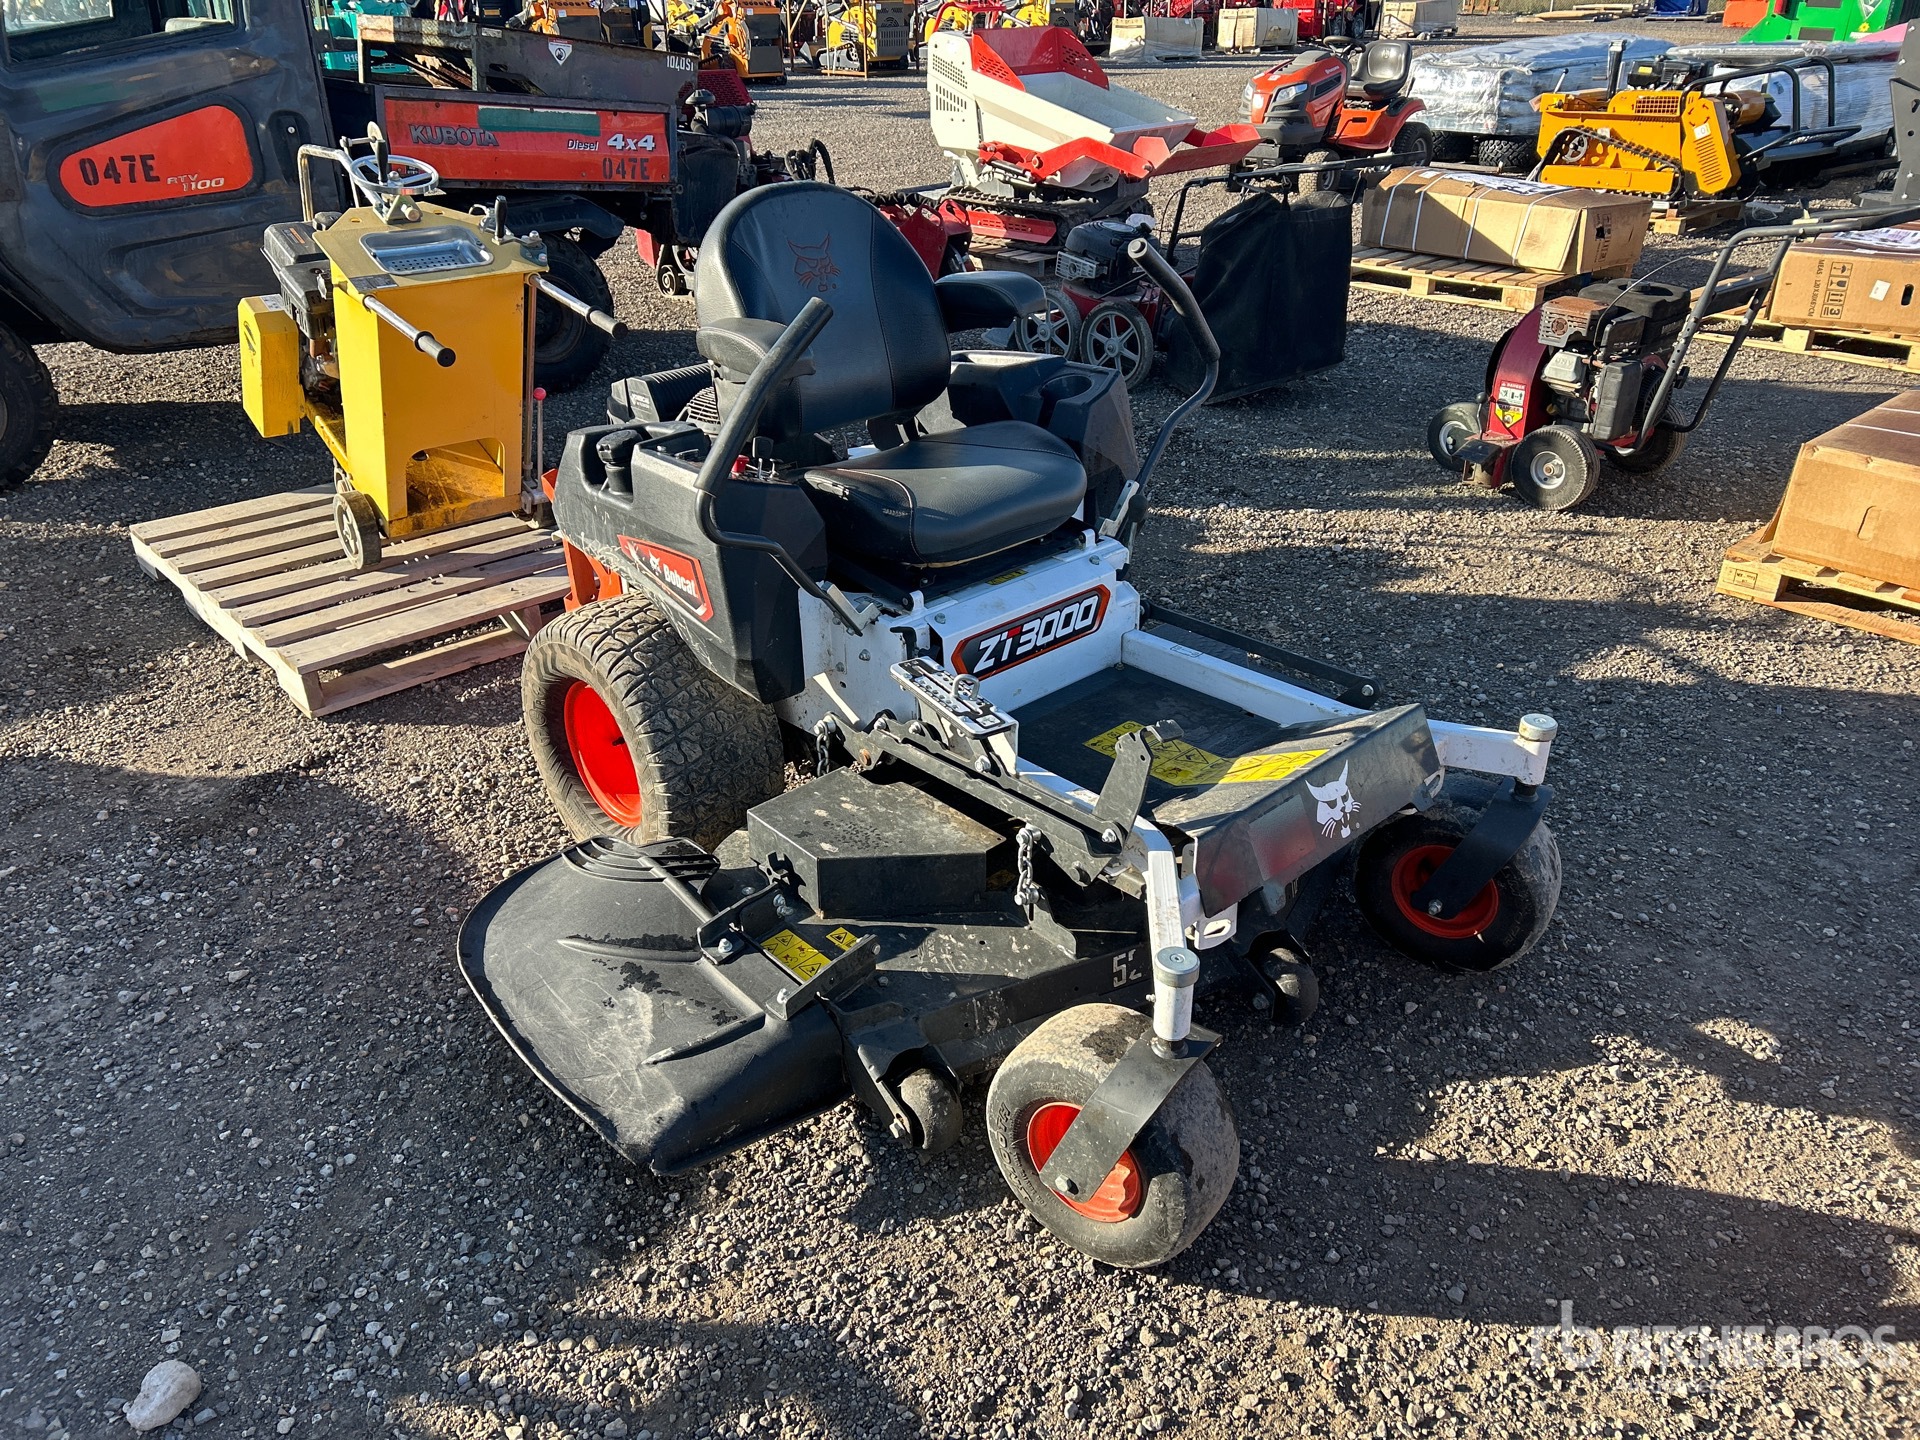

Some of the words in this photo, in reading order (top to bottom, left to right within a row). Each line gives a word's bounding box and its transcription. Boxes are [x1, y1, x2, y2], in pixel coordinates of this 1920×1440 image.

[409, 125, 499, 147] KUBOTA
[567, 139, 599, 150] Diesel
[607, 133, 655, 151] 4x4
[79, 154, 160, 186] 047E
[602, 157, 650, 180] 047E
[166, 174, 199, 185] RTV
[182, 177, 225, 192] 1100
[663, 563, 699, 599] Bobcat
